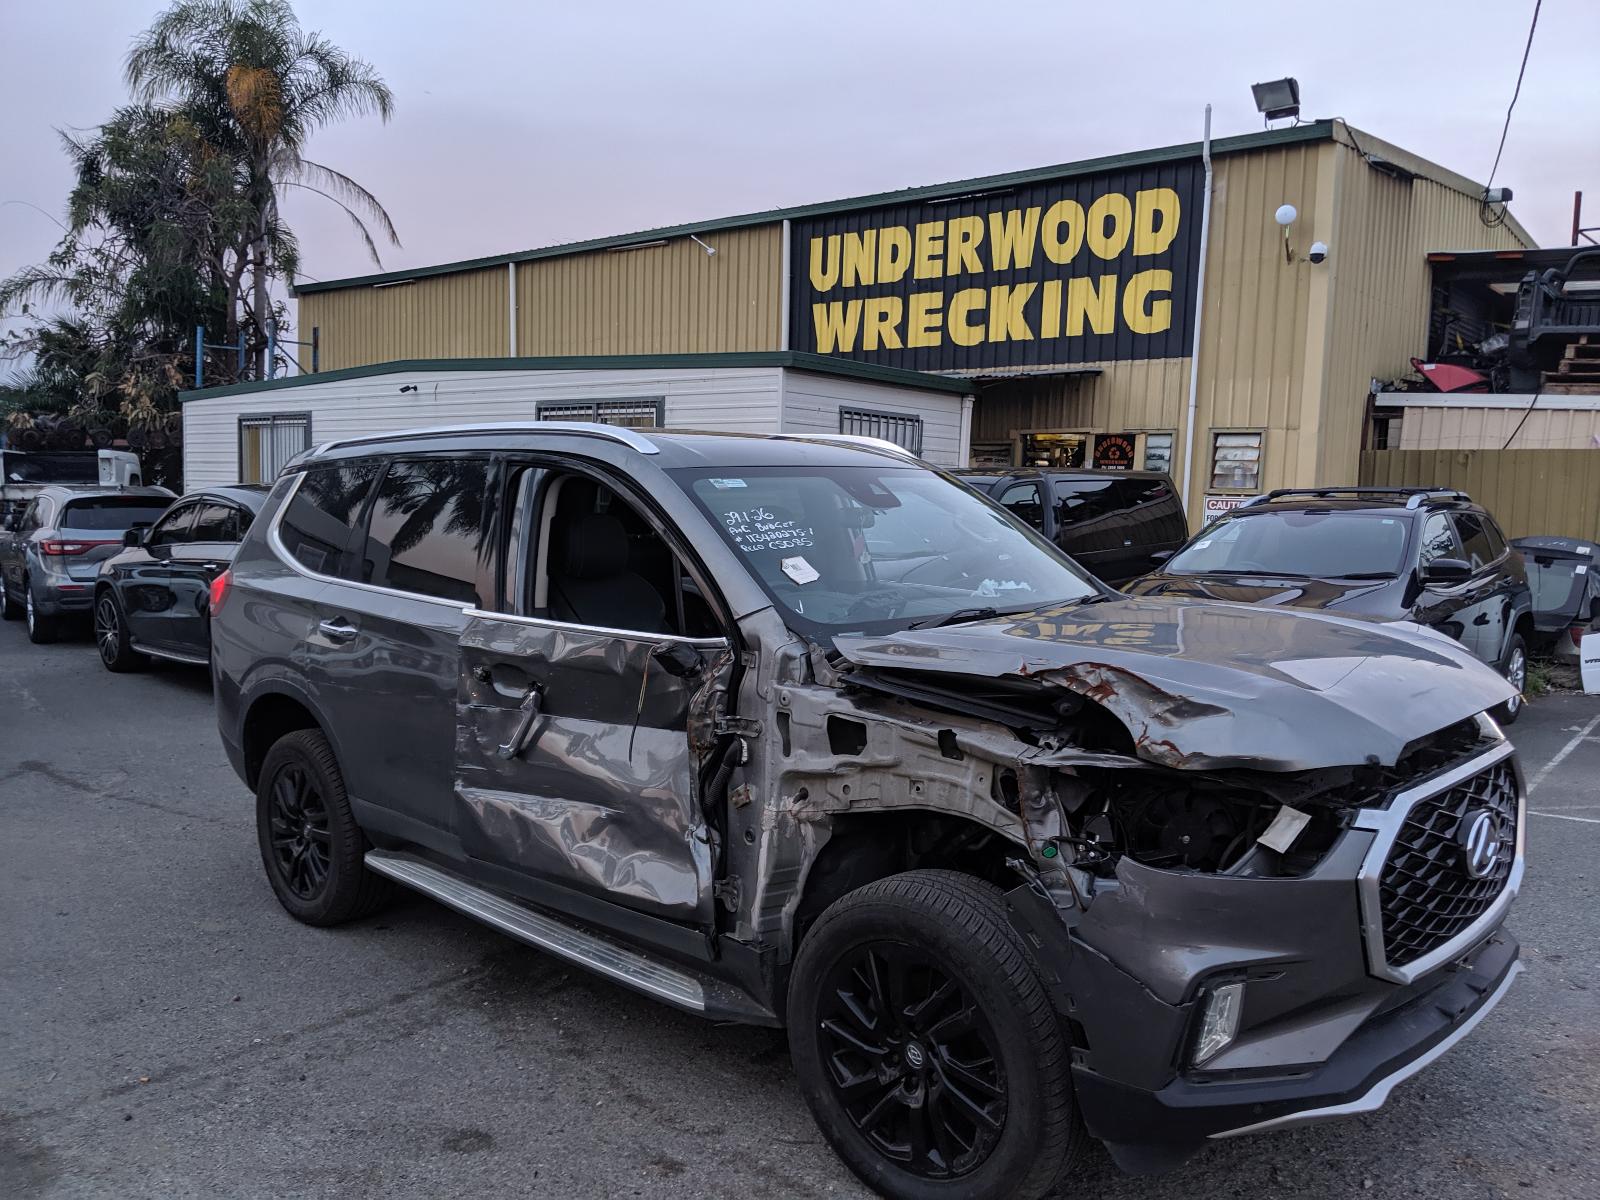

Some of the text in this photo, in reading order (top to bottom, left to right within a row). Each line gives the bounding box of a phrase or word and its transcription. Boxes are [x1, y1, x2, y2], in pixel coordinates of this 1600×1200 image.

[809, 188, 1181, 292] UNDERWOOD
[812, 269, 1173, 354] WRECKING
[1208, 500, 1246, 510] CAUTI
